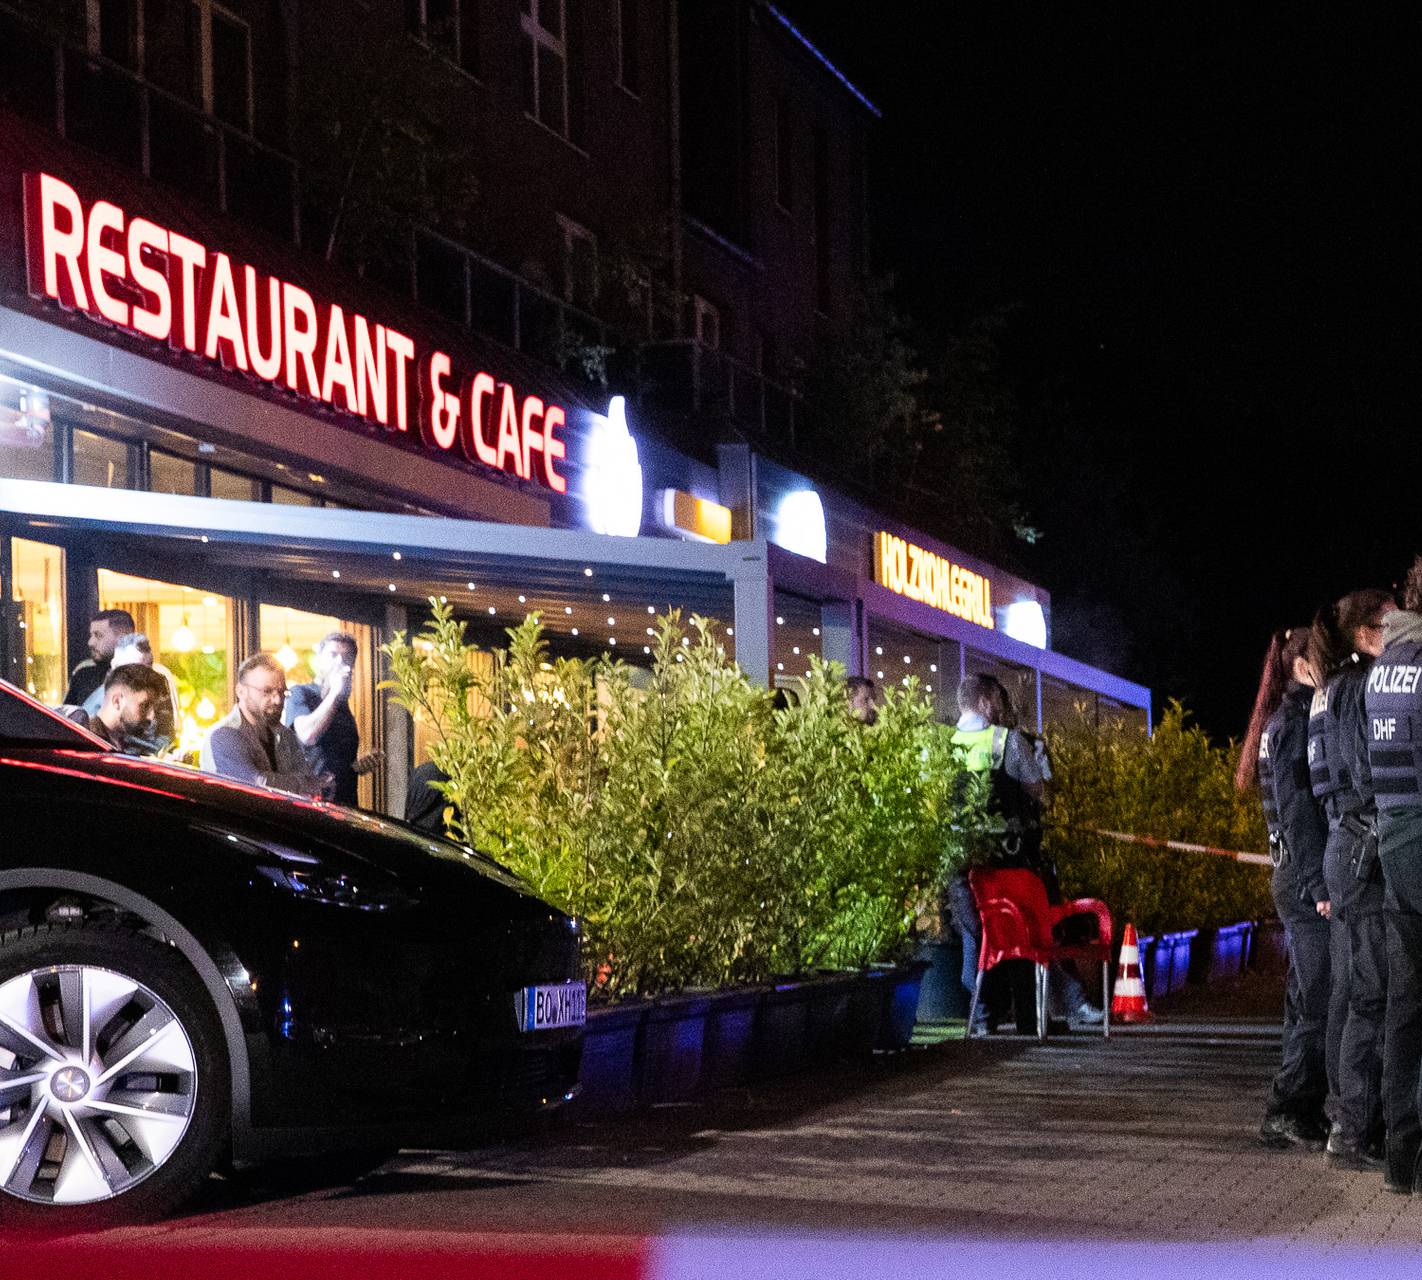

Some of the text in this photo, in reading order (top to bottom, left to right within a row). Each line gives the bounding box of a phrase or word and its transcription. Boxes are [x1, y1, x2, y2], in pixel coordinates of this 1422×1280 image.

[40, 172, 566, 495] RESTAURANT & CAFE
[880, 531, 994, 630] HOLZKOHLEGRILL
[1367, 665, 1422, 694] POLIZEI
[1372, 718, 1396, 741] DHF
[536, 991, 552, 1024] BO
